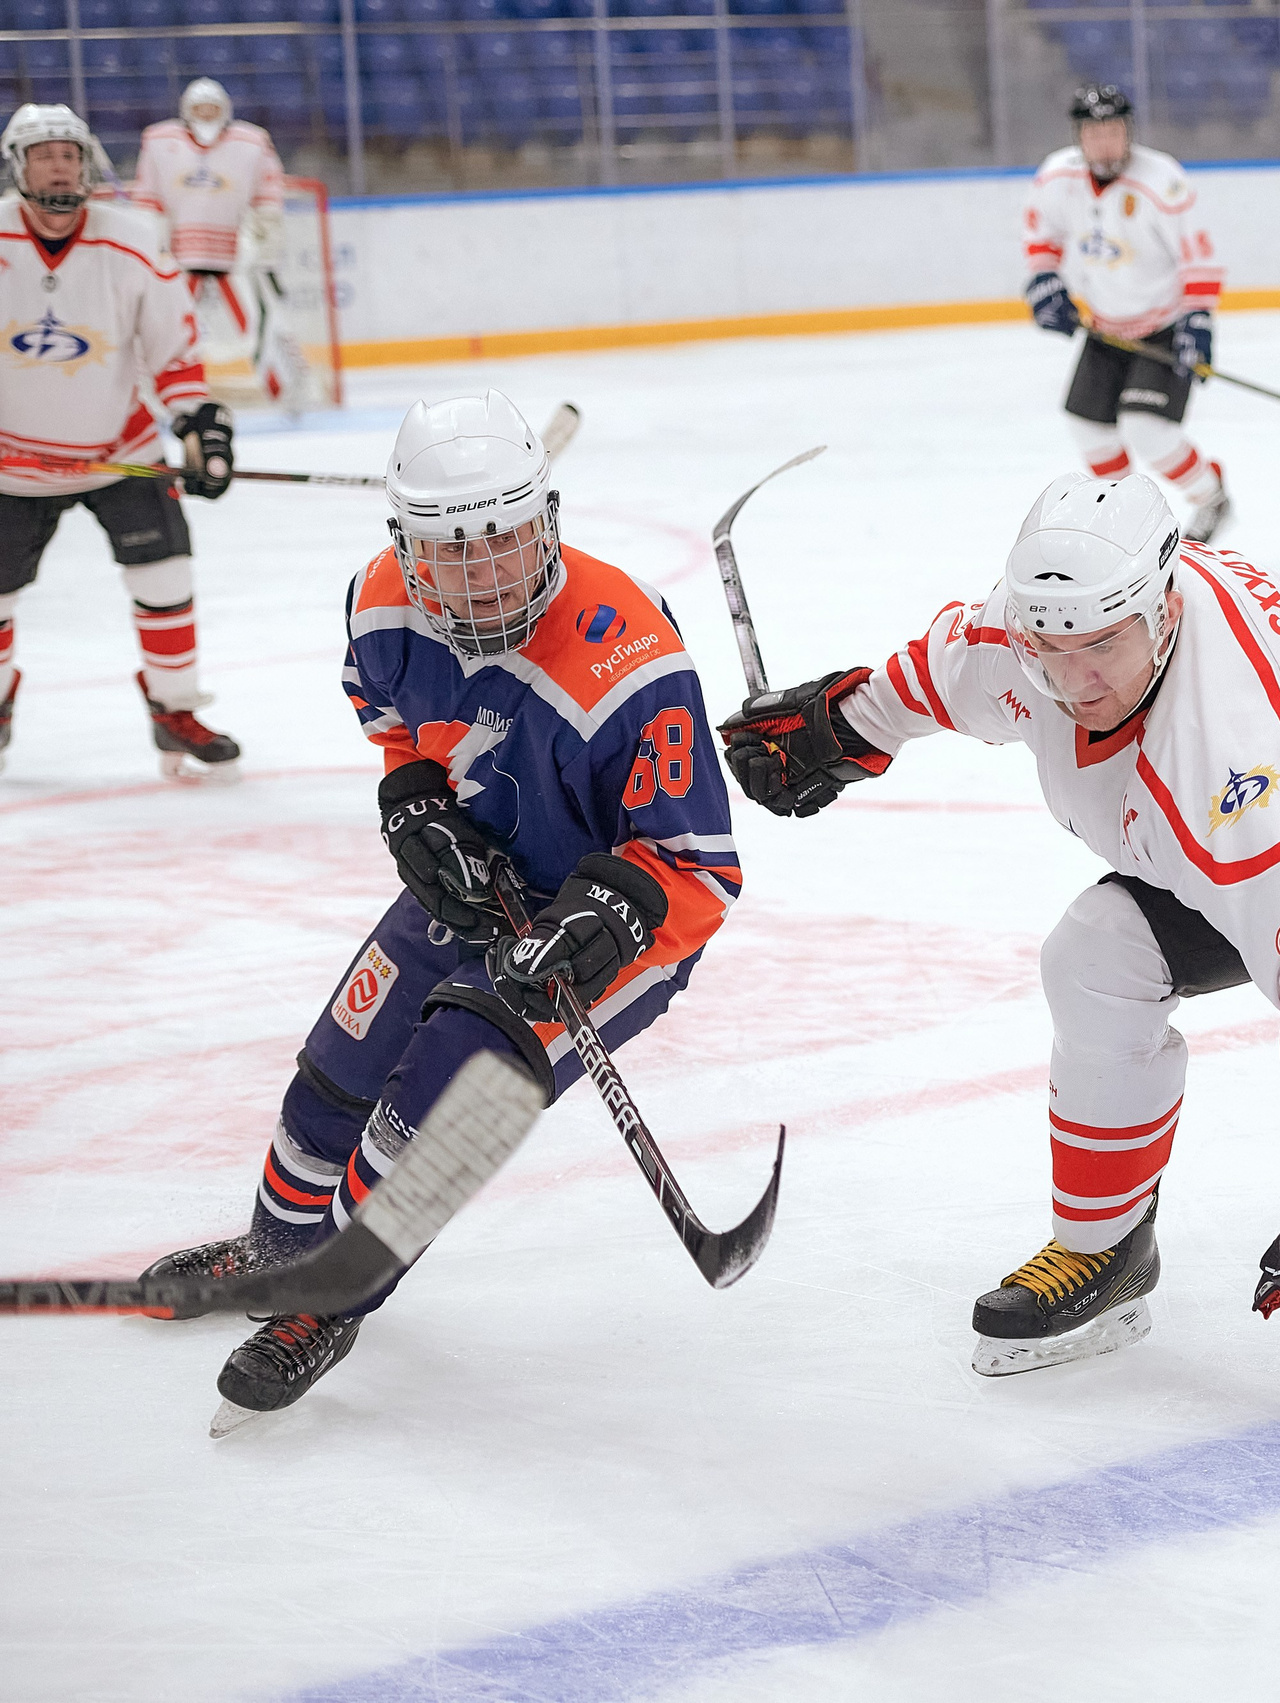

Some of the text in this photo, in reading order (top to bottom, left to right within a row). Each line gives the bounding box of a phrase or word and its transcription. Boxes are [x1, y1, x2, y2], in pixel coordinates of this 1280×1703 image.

[446, 498, 497, 514] BAUER
[590, 633, 659, 679] РусГидро
[333, 1001, 360, 1036] НПХЛ
[573, 1025, 641, 1139] BAUER
[1073, 1289, 1098, 1311] CCM
